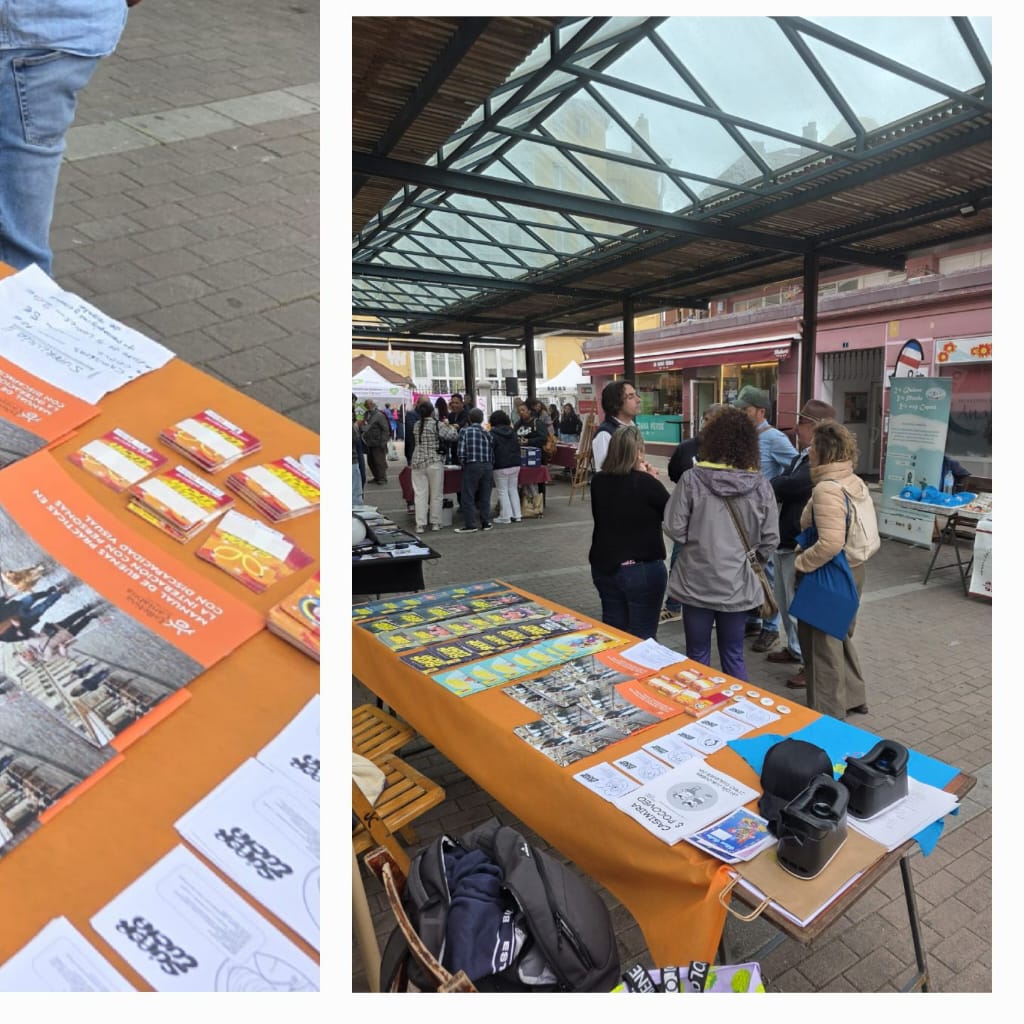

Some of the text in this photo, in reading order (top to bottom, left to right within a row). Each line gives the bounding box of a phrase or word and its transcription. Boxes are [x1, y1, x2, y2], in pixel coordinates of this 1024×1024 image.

[32, 489, 49, 504] EN
[54, 500, 106, 545] PERSONAS
[84, 514, 117, 545] VISUAL
[97, 549, 141, 581] BUENAS
[105, 543, 130, 563] CON
[119, 542, 196, 596] DISCAPACIDAD
[140, 579, 158, 593] DE
[159, 591, 209, 625] MANUAL
[196, 594, 224, 616] CON
[200, 607, 217, 621] LA
[632, 803, 671, 831] CASIMIRA
